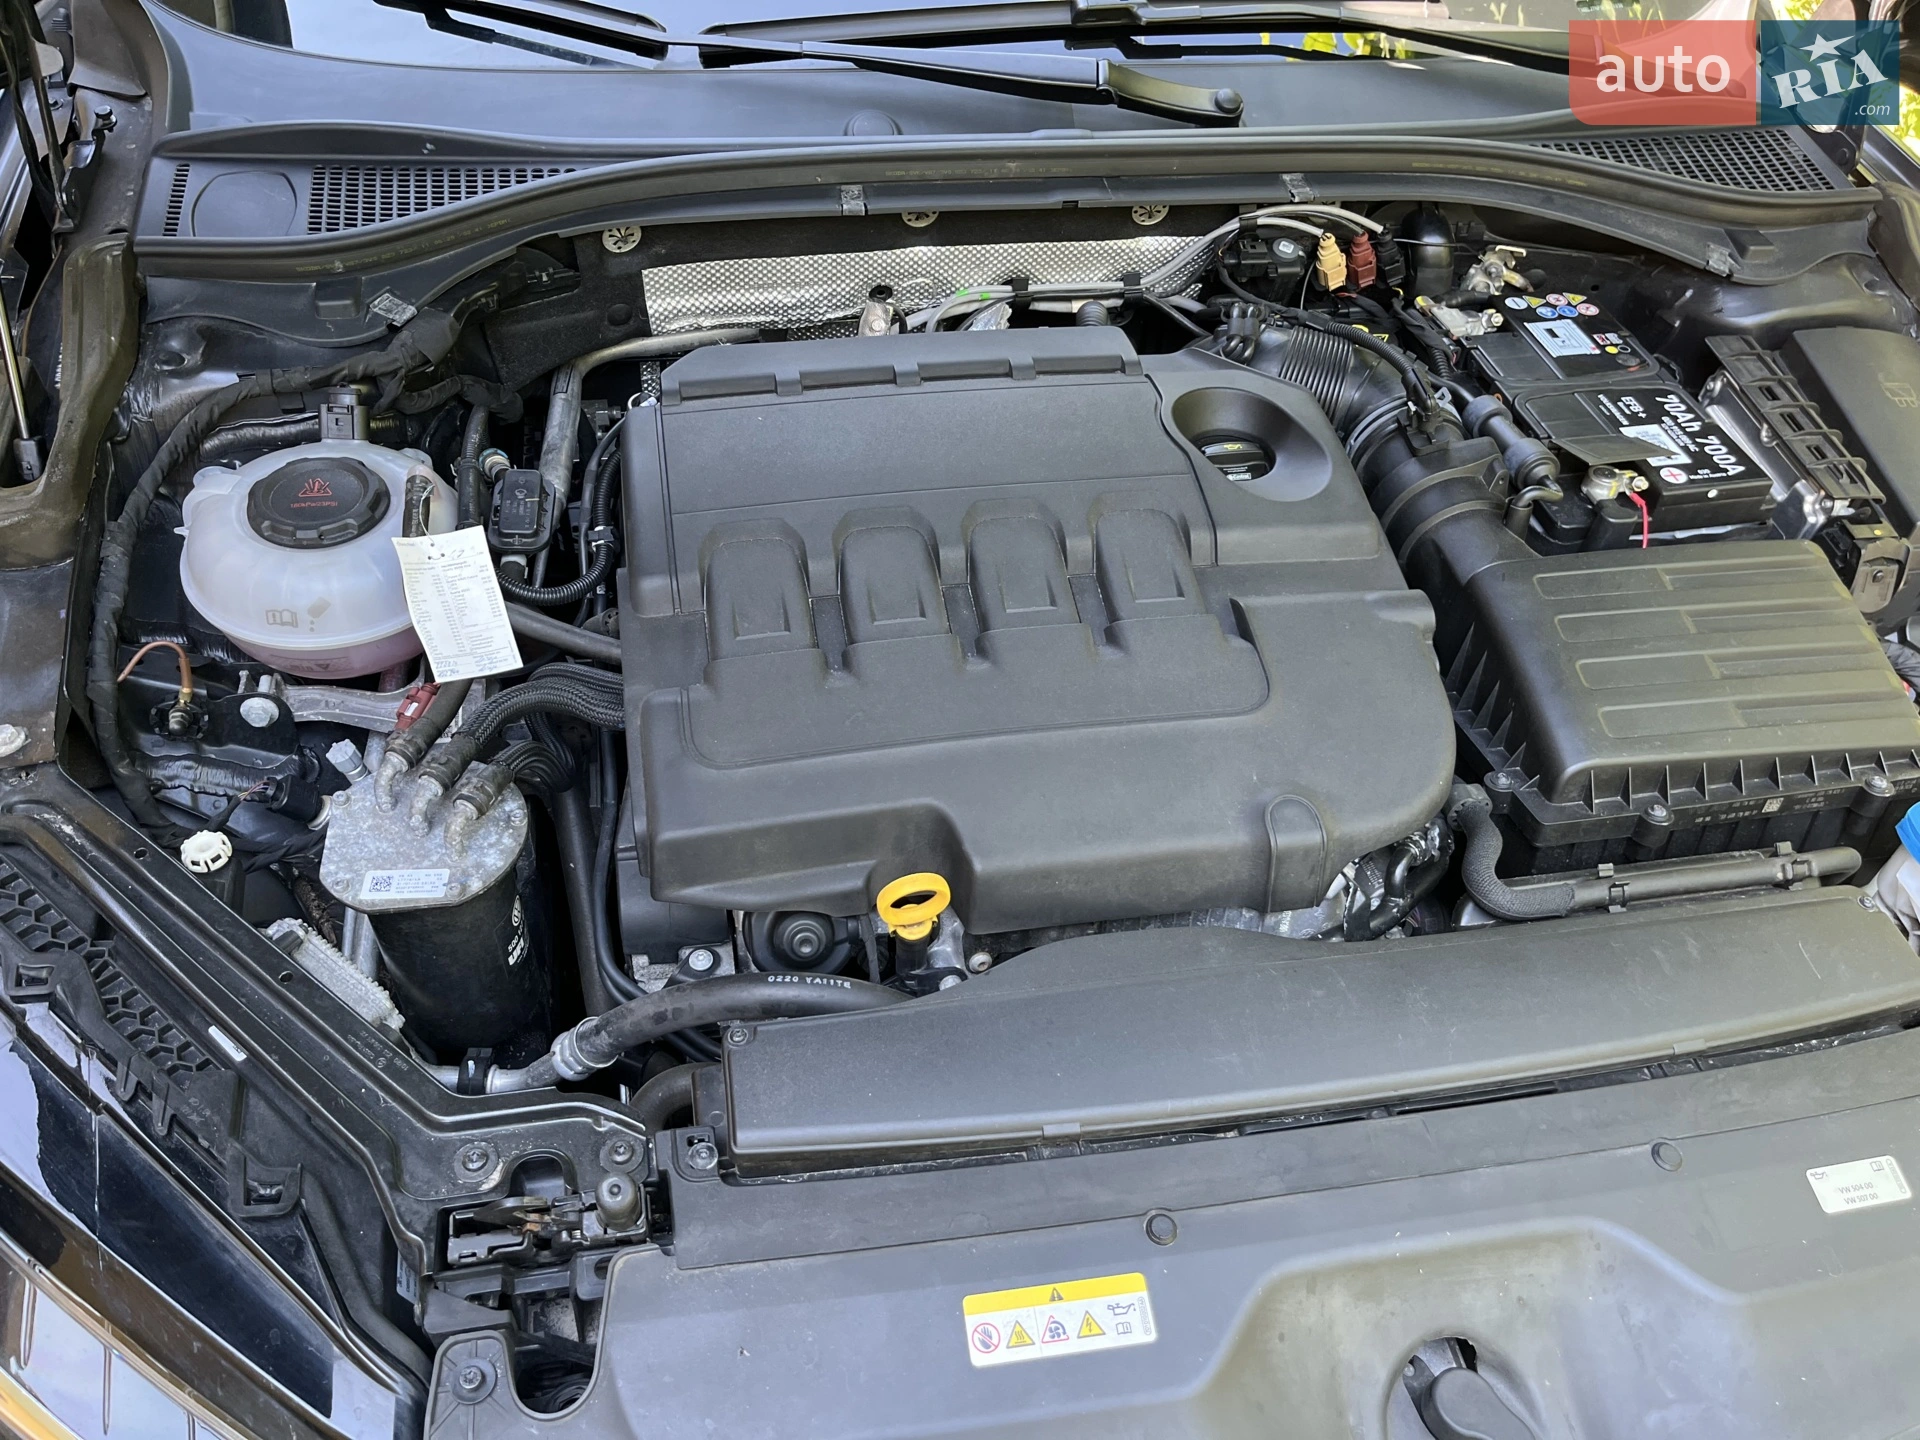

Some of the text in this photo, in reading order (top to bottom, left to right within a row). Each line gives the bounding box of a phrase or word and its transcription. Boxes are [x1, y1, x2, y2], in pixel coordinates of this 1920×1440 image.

[1655, 394, 1702, 432] 70Ah
[1694, 435, 1746, 476] 700A
[767, 975, 799, 983] 0220
[1838, 1181, 1874, 1194] VW 504 00
[1843, 1196, 1856, 1205] VW
[1869, 1192, 1879, 1201] 00
